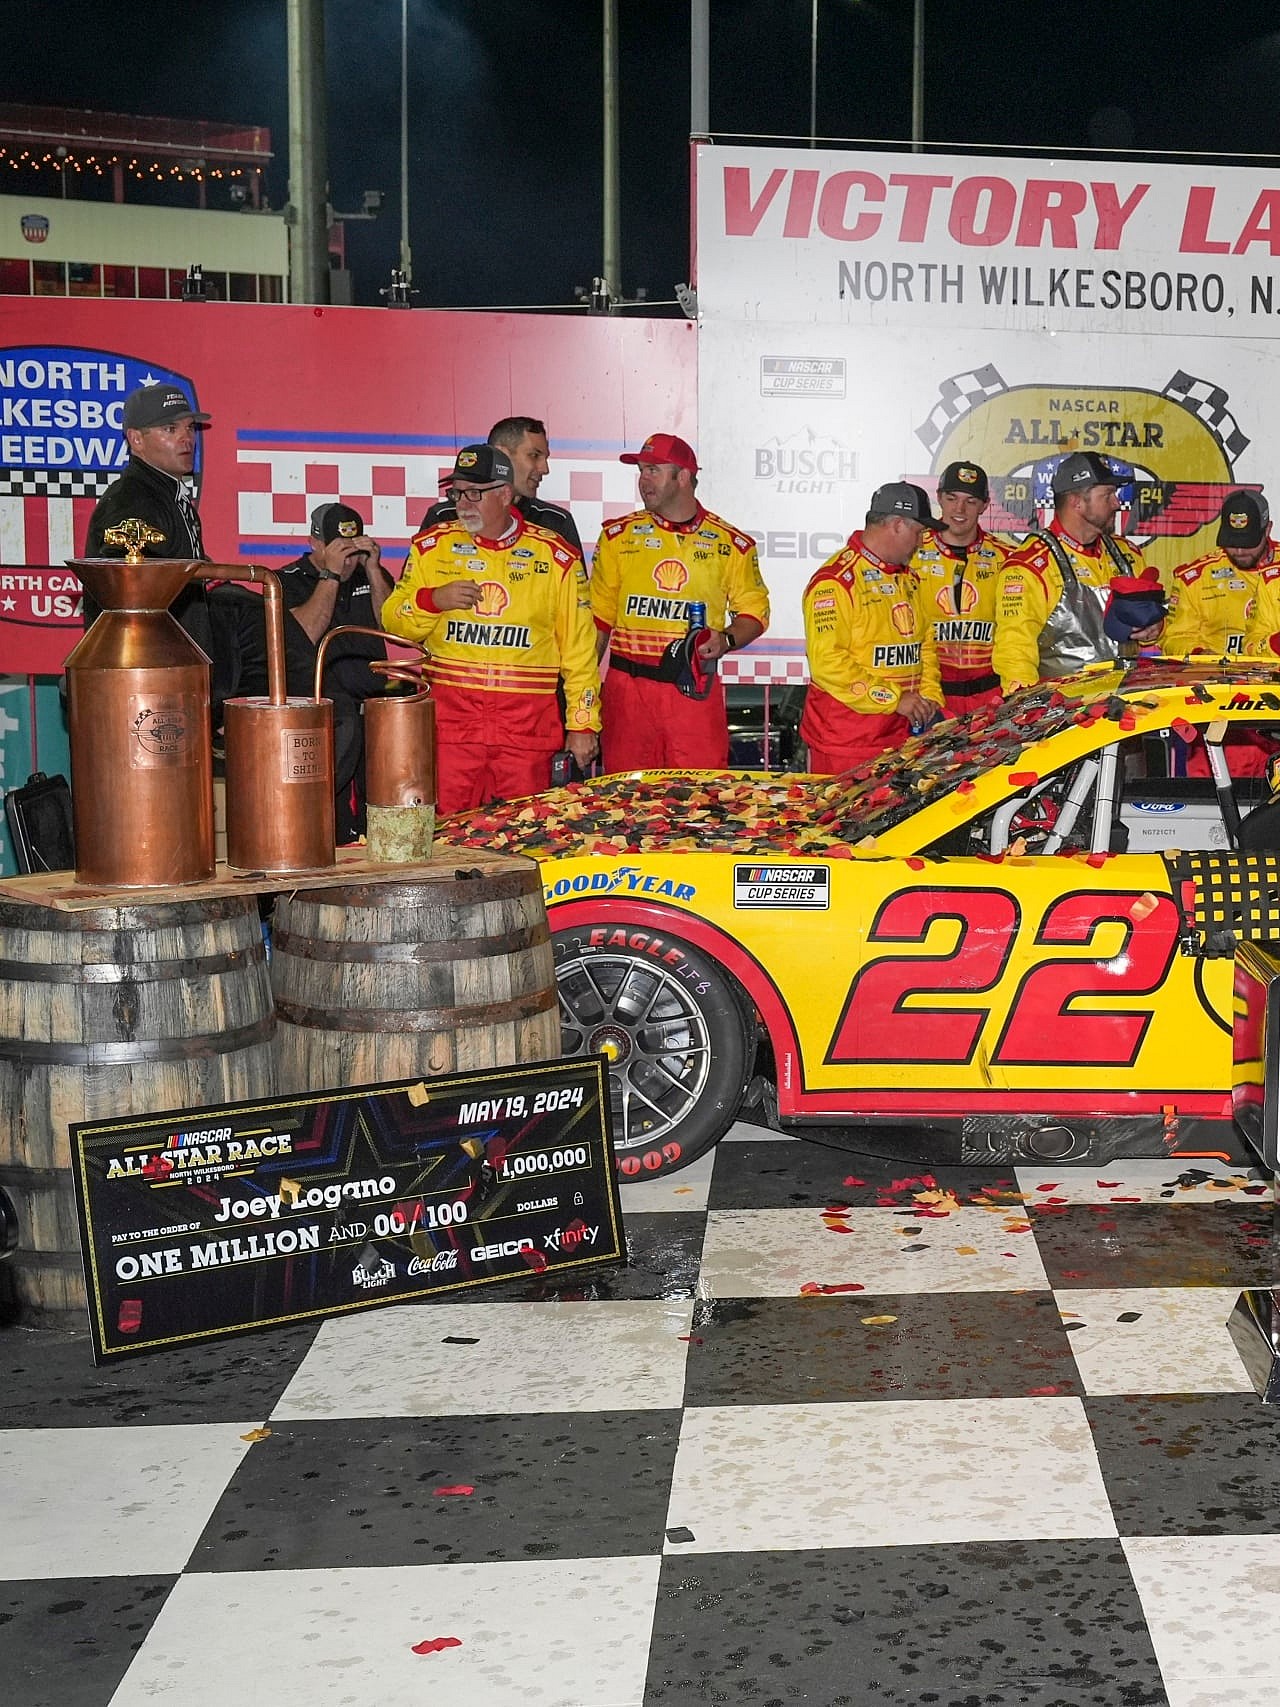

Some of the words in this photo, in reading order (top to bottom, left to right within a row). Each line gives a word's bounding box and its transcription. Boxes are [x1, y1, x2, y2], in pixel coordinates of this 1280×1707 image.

[724, 167, 1151, 250] VICTORY
[838, 260, 960, 304] NORTH
[981, 265, 1235, 317] WILKESBORO,
[0, 360, 126, 391] NORTH
[788, 361, 833, 374] NASCAR
[773, 377, 795, 388] CUP
[796, 379, 834, 389] SERIES
[1050, 399, 1119, 413] NASCAR
[1004, 418, 1069, 445] ALL
[1083, 420, 1164, 448] STAR
[755, 448, 859, 480] BUSCH
[776, 480, 835, 494] LIGHT
[1004, 485, 1027, 501] 20
[1140, 487, 1164, 504] 24
[743, 530, 844, 560] GEIC
[1, 575, 43, 591] RTH
[445, 621, 532, 649] PENNZOIL
[302, 752, 316, 760] TO
[543, 870, 696, 902] GOODYEAR
[766, 869, 815, 882] NASCAR
[748, 887, 772, 899] CUP
[773, 888, 816, 900] SERIES
[588, 928, 686, 966] EAGLE
[823, 886, 1183, 1067] 22
[458, 1099, 503, 1125] MAY
[505, 1096, 529, 1118] 19,
[532, 1087, 584, 1114] 2024
[183, 1128, 232, 1147] NASCAR
[158, 1146, 222, 1172] STAR
[227, 1134, 292, 1161] RACE
[502, 1147, 587, 1180] 1,000,000
[169, 1171, 192, 1180] NORTH
[193, 1164, 235, 1177] WILKESBORO
[214, 1194, 281, 1222] Joey
[289, 1176, 396, 1210] Logano
[517, 1197, 559, 1212] DOLLARS
[111, 1235, 127, 1243] PAY
[129, 1231, 141, 1240] TO
[142, 1228, 159, 1237] THE
[160, 1223, 189, 1235] ORDER
[189, 1222, 201, 1231] OF
[544, 1224, 600, 1251] xfinity
[115, 1248, 182, 1281] ONE
[190, 1226, 320, 1268] MILLION
[328, 1222, 367, 1242] AND
[407, 1249, 459, 1276] Coca-Cola
[470, 1238, 534, 1262] GEICO
[363, 1279, 387, 1288] LIGHT
